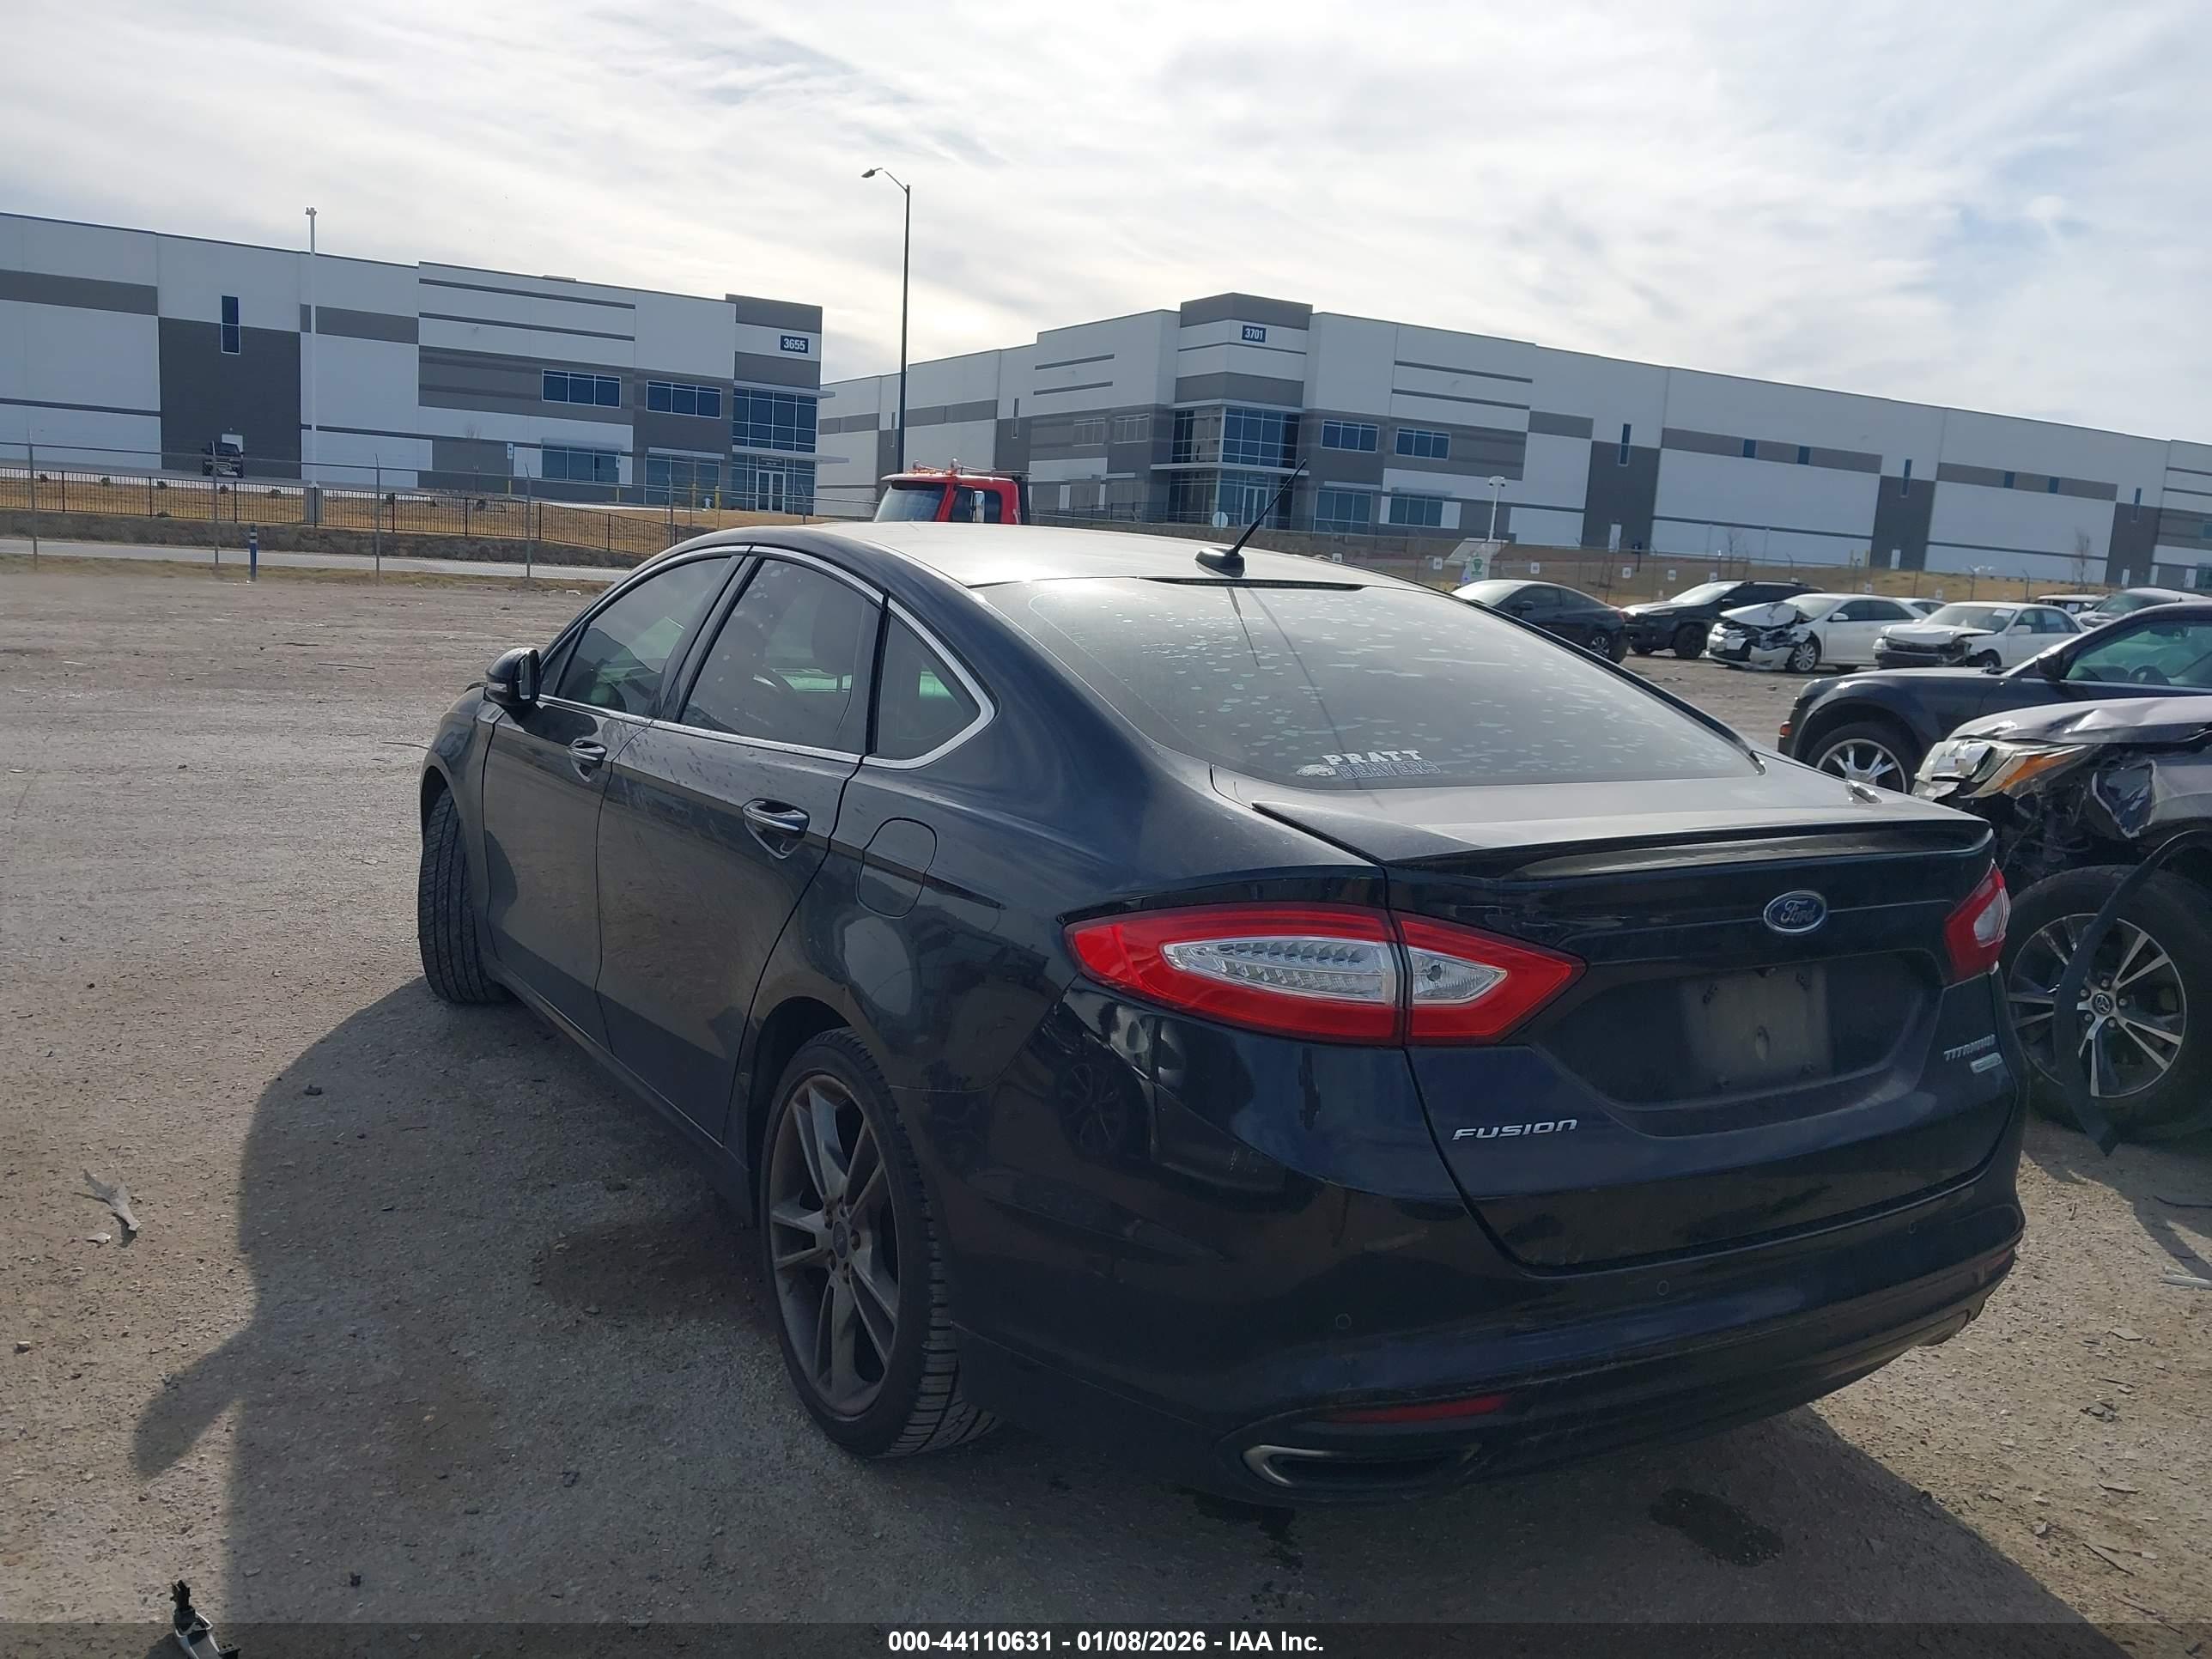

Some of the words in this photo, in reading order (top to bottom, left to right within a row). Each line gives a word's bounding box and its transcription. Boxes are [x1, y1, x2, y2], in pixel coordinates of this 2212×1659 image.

[1245, 327, 1263, 340] 3701
[783, 337, 805, 350] 3655
[1322, 750, 1423, 766] PRATT
[1333, 760, 1442, 781] BEAVERS
[1452, 1119, 1578, 1140] FUSION
